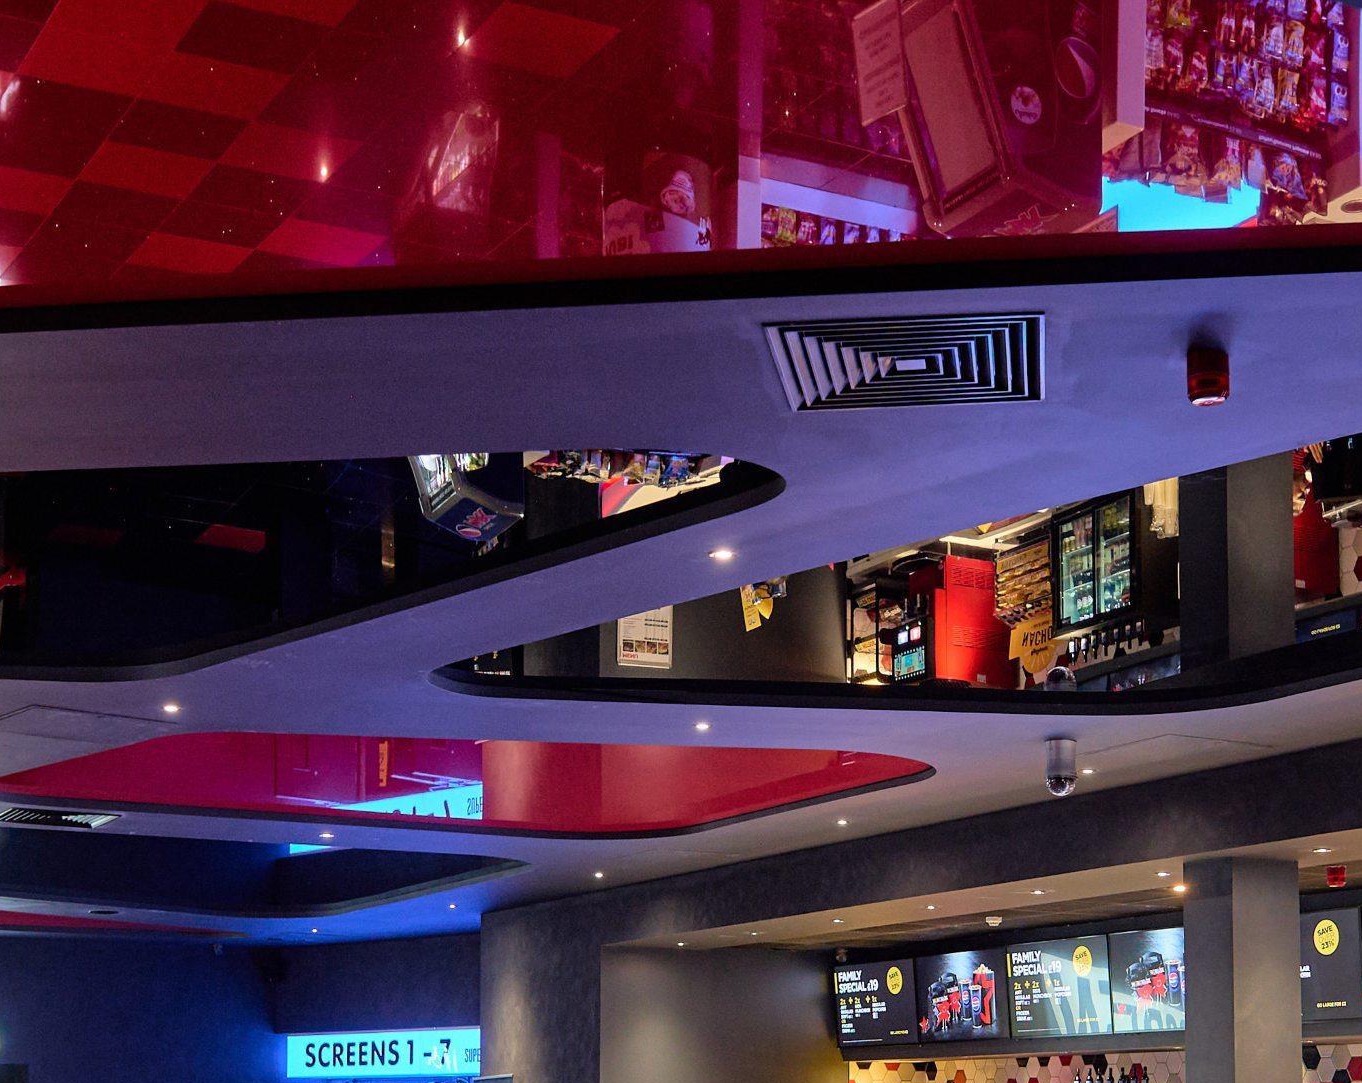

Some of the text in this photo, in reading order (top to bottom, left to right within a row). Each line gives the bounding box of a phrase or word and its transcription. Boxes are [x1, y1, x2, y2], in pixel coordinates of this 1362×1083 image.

[1317, 925, 1333, 936] SAVE
[1011, 950, 1041, 964] FAMILY
[838, 970, 862, 982] FAMILY
[1013, 964, 1047, 977] SPECIAL
[839, 981, 867, 994] SPECIAL
[305, 1040, 399, 1068] SCREENS
[407, 1039, 414, 1064] 1
